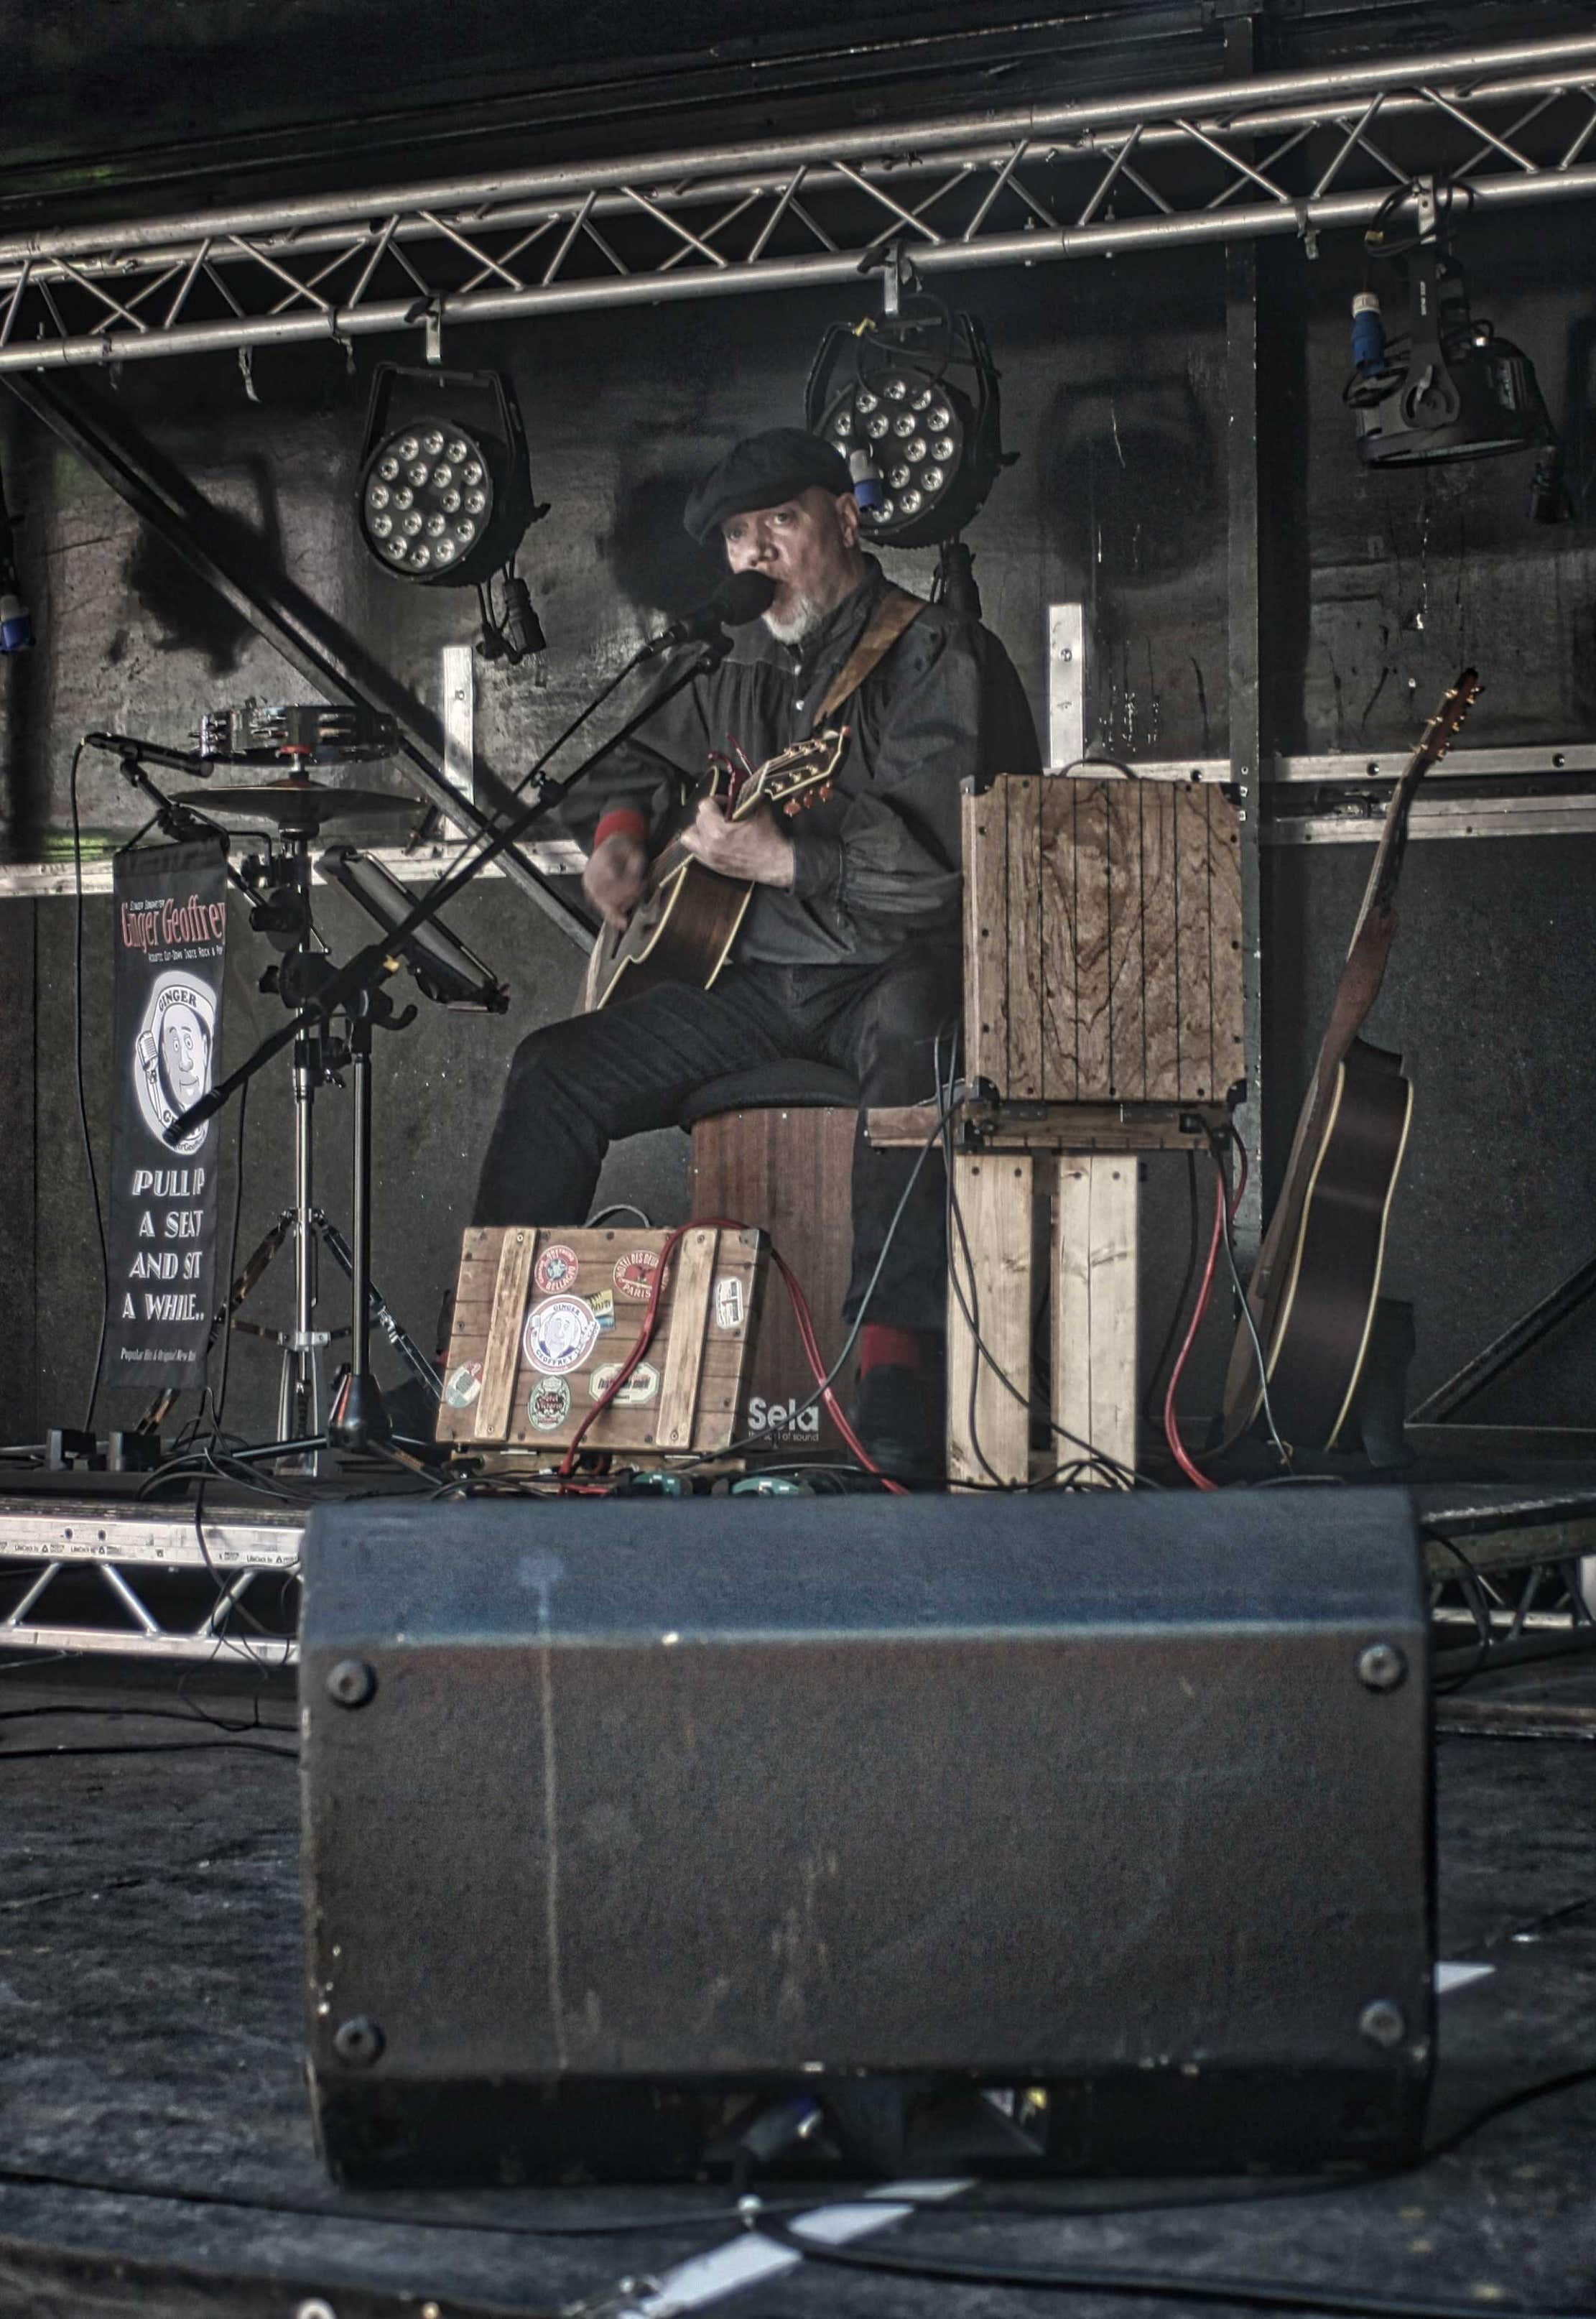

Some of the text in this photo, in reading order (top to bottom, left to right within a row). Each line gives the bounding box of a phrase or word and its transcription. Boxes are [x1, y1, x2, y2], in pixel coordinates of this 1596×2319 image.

[163, 894, 226, 945] Geoffrey
[158, 989, 198, 1011] GINGER
[131, 1167, 205, 1196] PULL P
[139, 1210, 204, 1238] A SEAT
[129, 1251, 203, 1279] AND SIT
[623, 1282, 651, 1298] PARIS
[122, 1292, 136, 1319] A
[553, 1303, 580, 1315] GINGER
[536, 1349, 573, 1366] GEOFFREY
[748, 1397, 819, 1431] Sela
